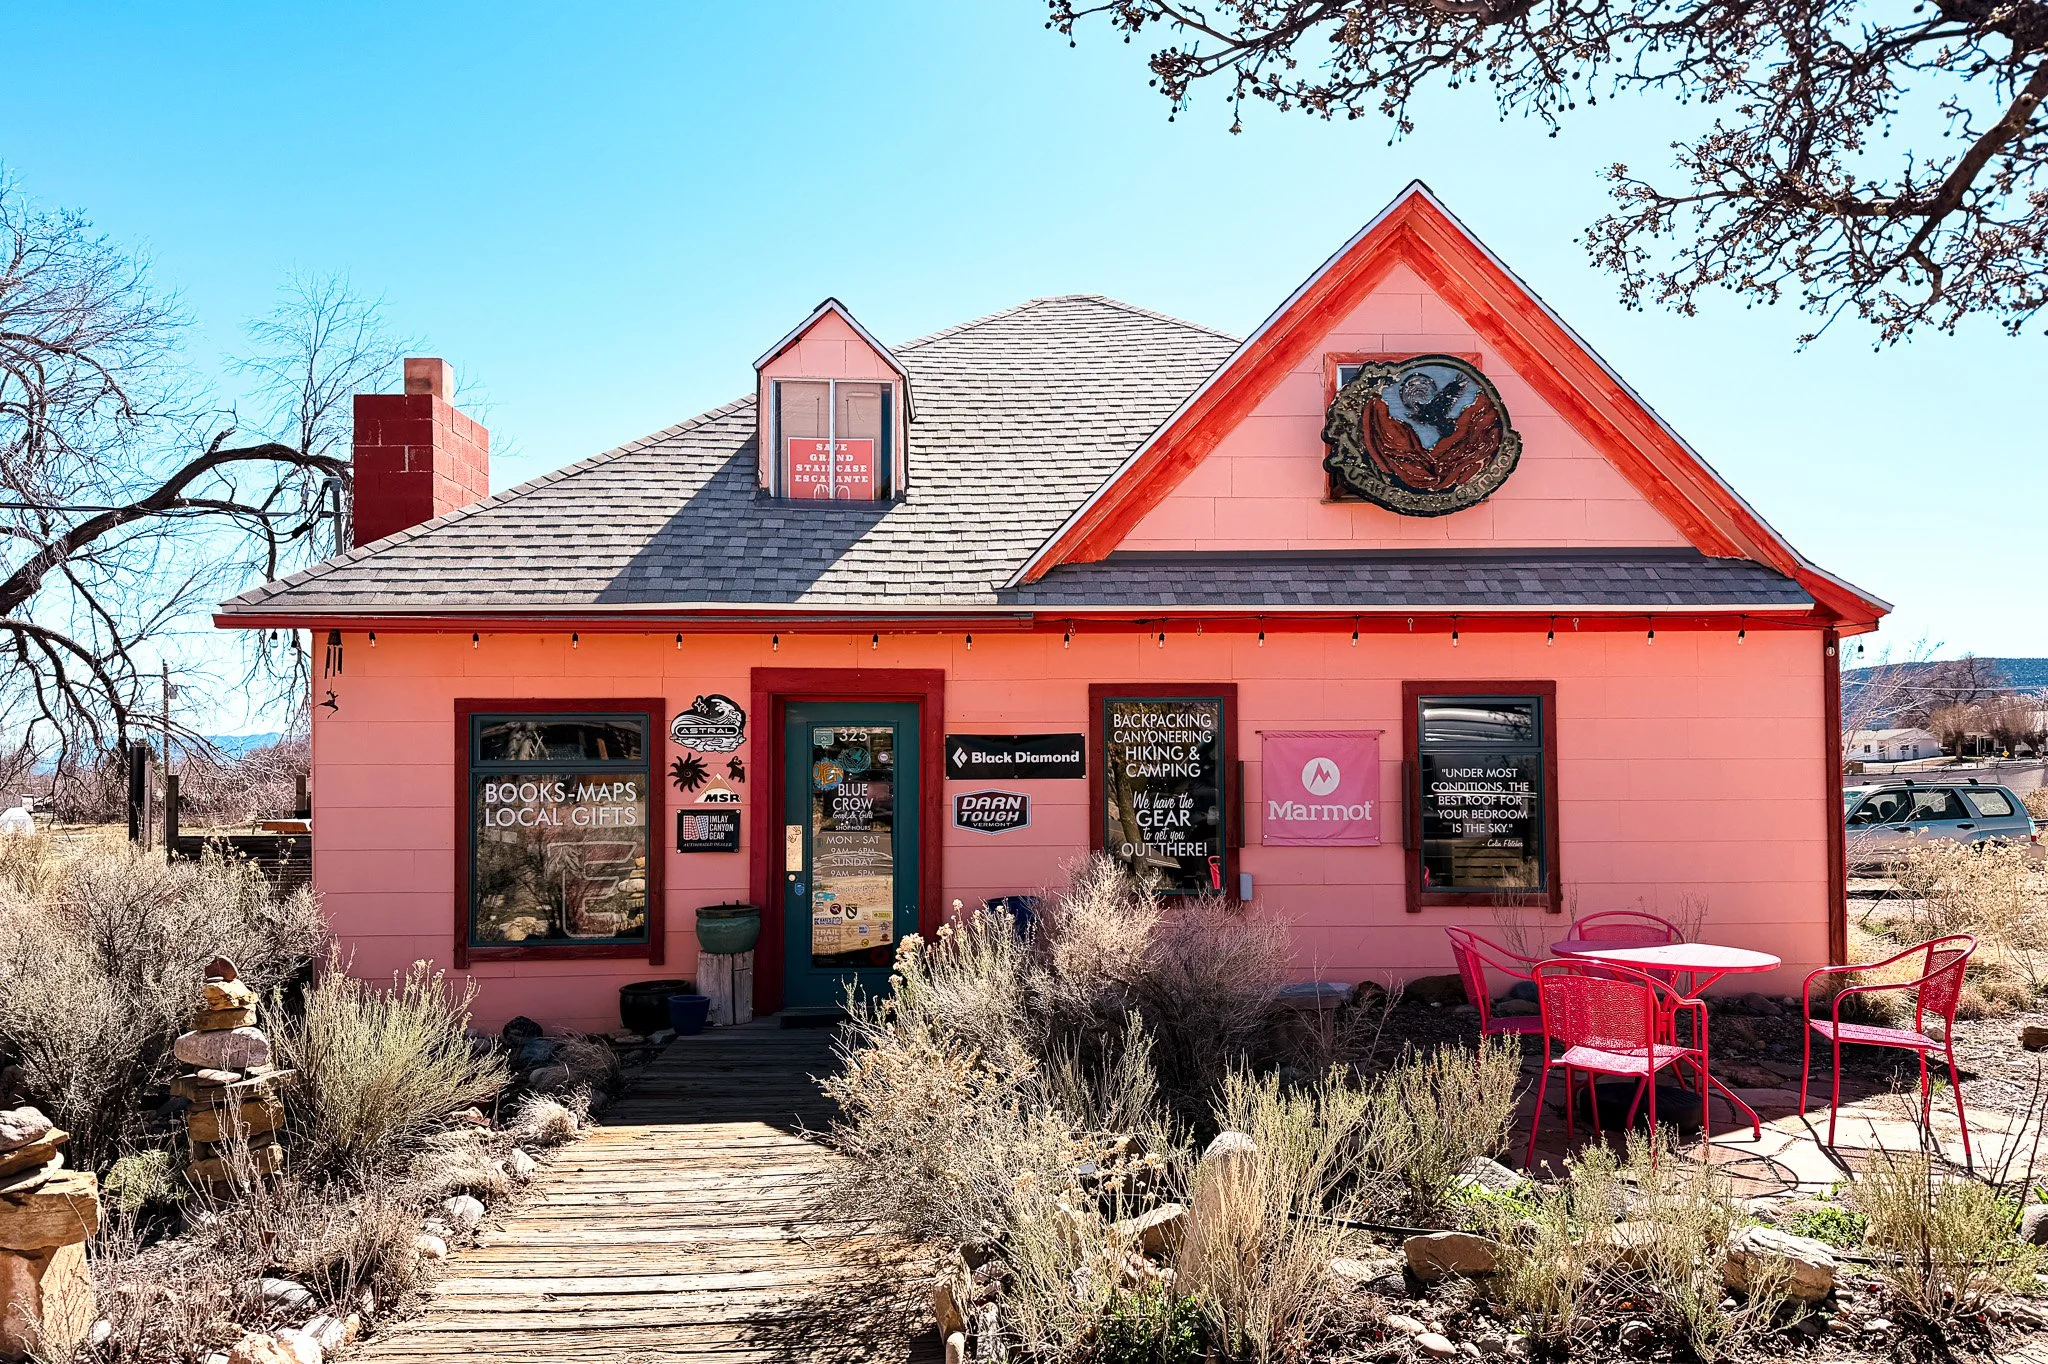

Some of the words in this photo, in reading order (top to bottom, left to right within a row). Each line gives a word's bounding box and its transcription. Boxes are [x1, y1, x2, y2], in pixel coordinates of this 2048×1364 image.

[809, 454, 854, 462] GRND
[1113, 713, 1212, 728] BACKPACKING
[839, 728, 868, 742] 325
[1113, 730, 1212, 744] CANYONEERING
[971, 751, 1012, 764] Black
[1015, 750, 1080, 763] Diamond
[1125, 746, 1184, 761] HIKING
[1188, 746, 1200, 761] &
[812, 762, 844, 785] OPEN
[1125, 762, 1201, 778] CAMPING
[1441, 768, 1484, 778] "UNDER
[1486, 768, 1518, 778] MOST
[485, 782, 637, 804] BOOKS-MAPS
[838, 783, 868, 797] BLUE
[1431, 782, 1504, 792] CONDITIONS,
[1508, 782, 1529, 792] THE
[703, 793, 741, 803] MSR
[832, 797, 874, 811] CROW
[961, 796, 1022, 810] DARN
[1132, 790, 1150, 809] We
[1153, 793, 1176, 809] have
[1178, 792, 1194, 809] the
[1438, 795, 1462, 805] BEST
[1465, 795, 1498, 805] ROOF
[1500, 795, 1523, 805] FOR
[485, 807, 563, 827] LOCAL
[571, 806, 637, 826] GIFTS
[960, 811, 1020, 823] TOUGH
[1267, 800, 1372, 821] Marmot
[1437, 809, 1469, 820] YOUR
[1471, 809, 1528, 820] BEDROOM
[709, 815, 729, 823] IMLAY
[1135, 810, 1191, 827] GEAR
[709, 823, 734, 832] CANYON
[1452, 823, 1462, 833] IS
[1464, 823, 1485, 833] THE
[1488, 823, 1513, 833] SKY."
[709, 832, 725, 840] GEAR
[826, 835, 853, 844] MON
[862, 835, 880, 844] SAT
[1143, 826, 1152, 841] to
[1154, 826, 1169, 845] get
[1170, 829, 1185, 845] you
[1121, 842, 1156, 857] OUT
[1157, 842, 1208, 857] THERE!
[1487, 839, 1501, 847] Colin
[830, 847, 850, 855] 9AM
[857, 847, 875, 855] 6PM
[832, 857, 874, 866] SUNDAY
[830, 869, 850, 877] 9AM
[857, 869, 875, 877] 5PM
